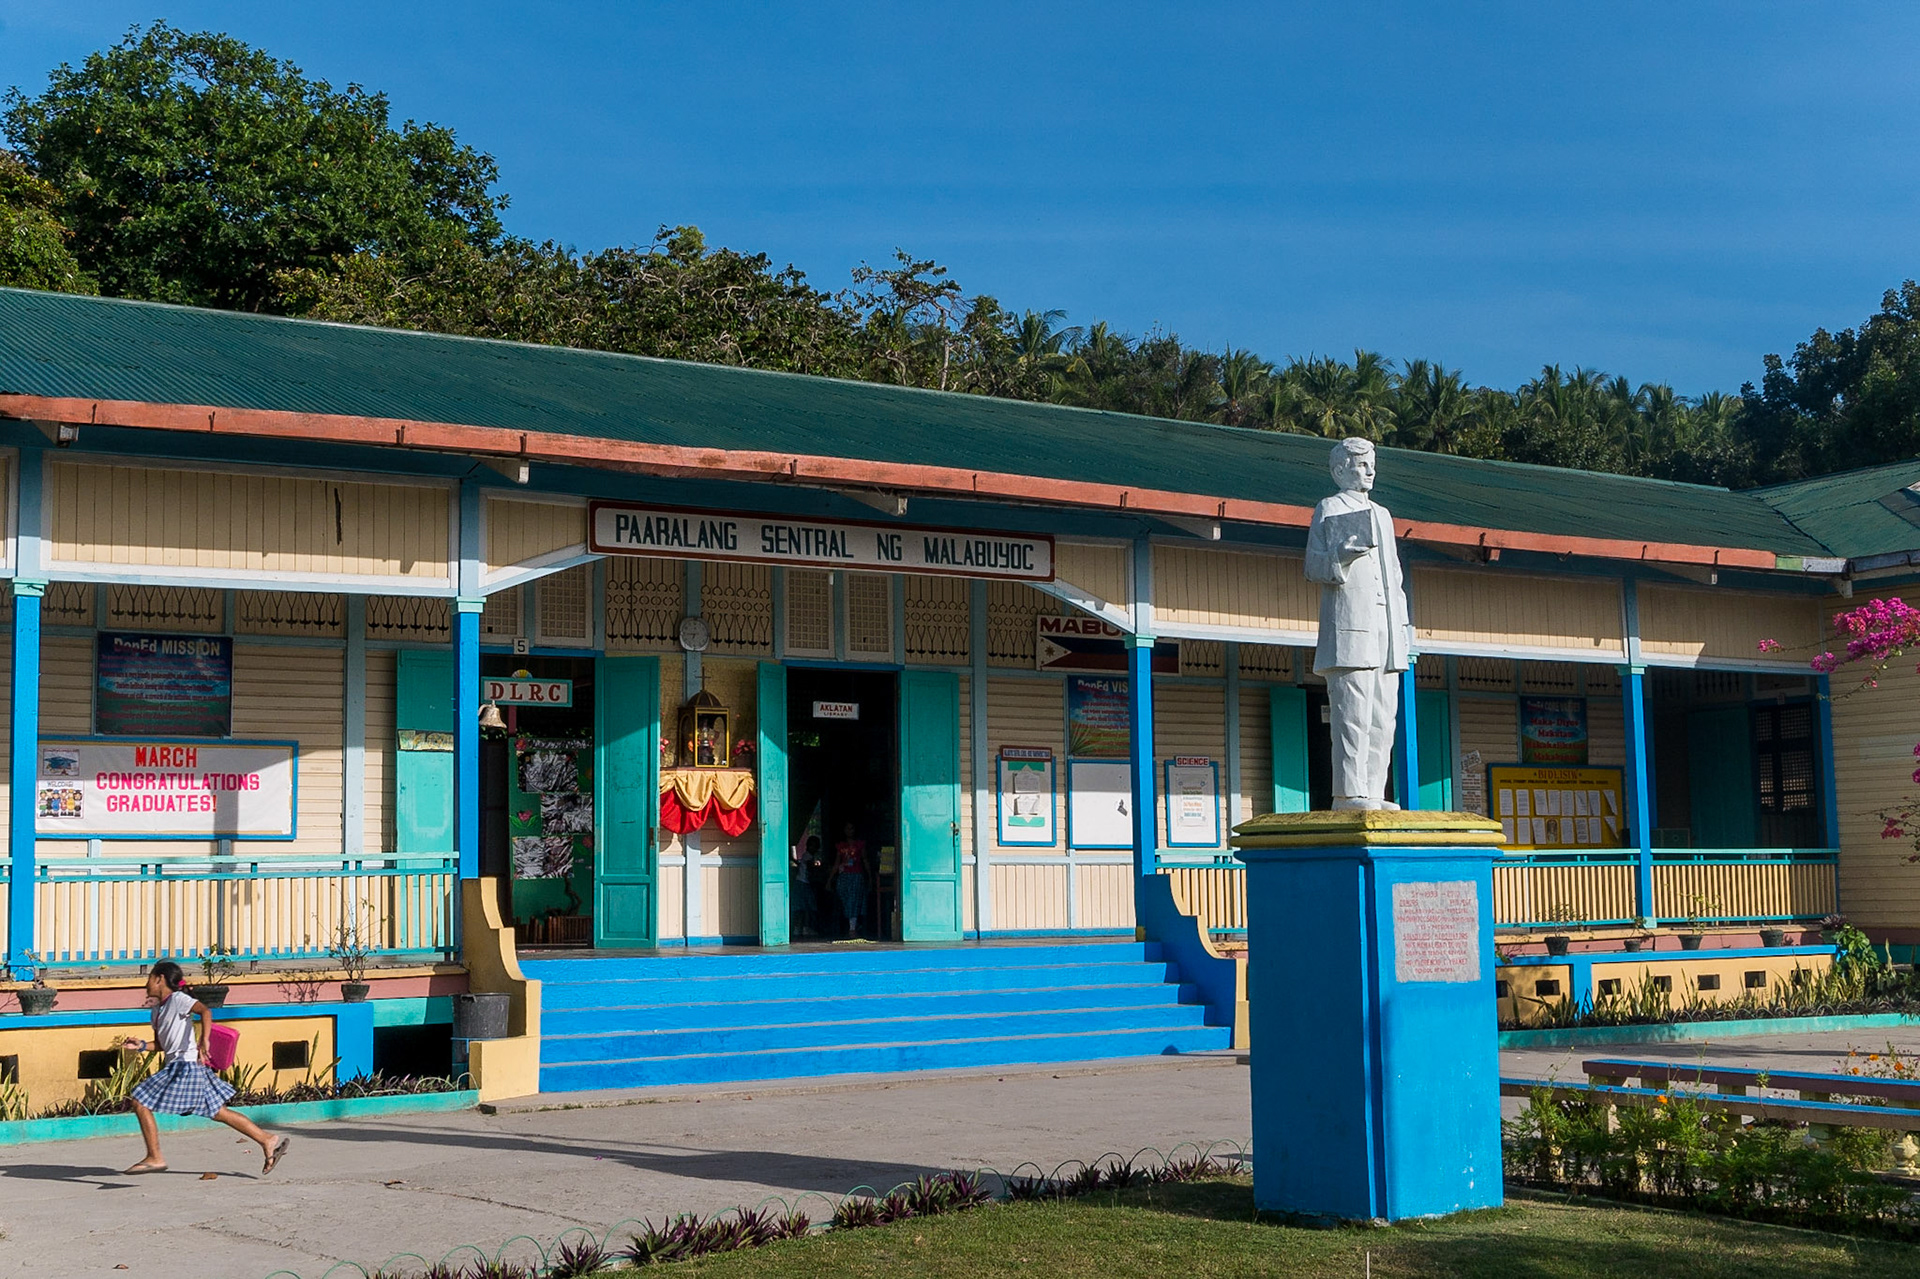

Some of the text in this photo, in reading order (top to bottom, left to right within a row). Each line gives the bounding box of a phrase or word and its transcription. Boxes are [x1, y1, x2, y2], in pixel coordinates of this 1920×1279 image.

[615, 514, 1034, 571] PAARALANG SENTRAL NG MALABUYOC
[1040, 617, 1125, 637] MABU
[161, 639, 220, 656] MISSION
[517, 640, 526, 653] 5
[1111, 681, 1129, 693] VIS
[820, 704, 853, 712] AKLATAN
[135, 746, 198, 769] MARCH
[1177, 757, 1209, 766] SCIENCE
[96, 772, 260, 791] CONGRATULATIONS
[106, 795, 217, 813] GRADUATES!
